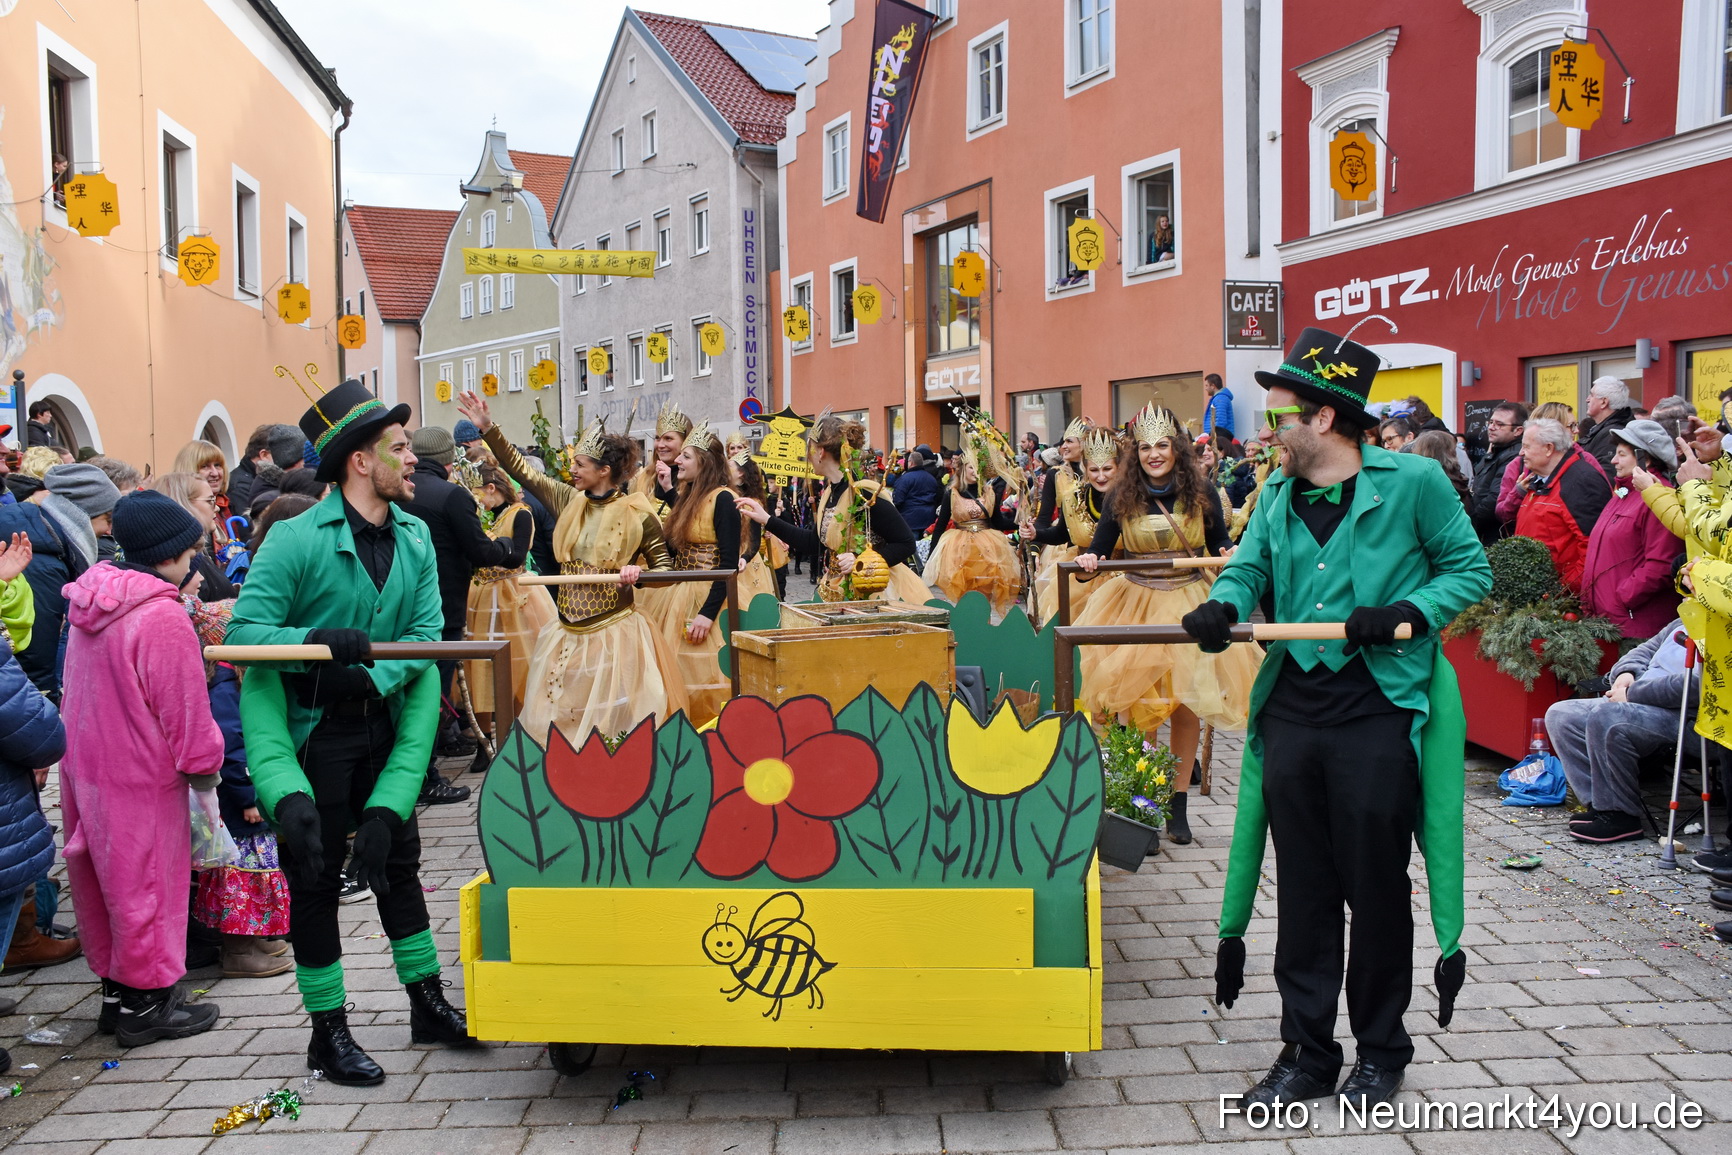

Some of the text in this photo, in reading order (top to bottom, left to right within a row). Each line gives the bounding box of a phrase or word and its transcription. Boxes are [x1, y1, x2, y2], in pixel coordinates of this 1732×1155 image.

[1556, 88, 1573, 114] 人
[1581, 77, 1600, 108] 华
[100, 201, 113, 216] 华
[76, 217, 87, 229] 人
[1446, 244, 1509, 300] Mode
[1512, 252, 1581, 300] Genuss
[1591, 208, 1690, 271] Erlebnis
[1476, 238, 1732, 335] Mode Genuss
[744, 209, 757, 398] UHREN SCHMUCK
[1231, 289, 1275, 312] CAFÉ
[925, 364, 980, 391] GÖTZ
[759, 461, 781, 470] flixte
[776, 477, 787, 485] 36
